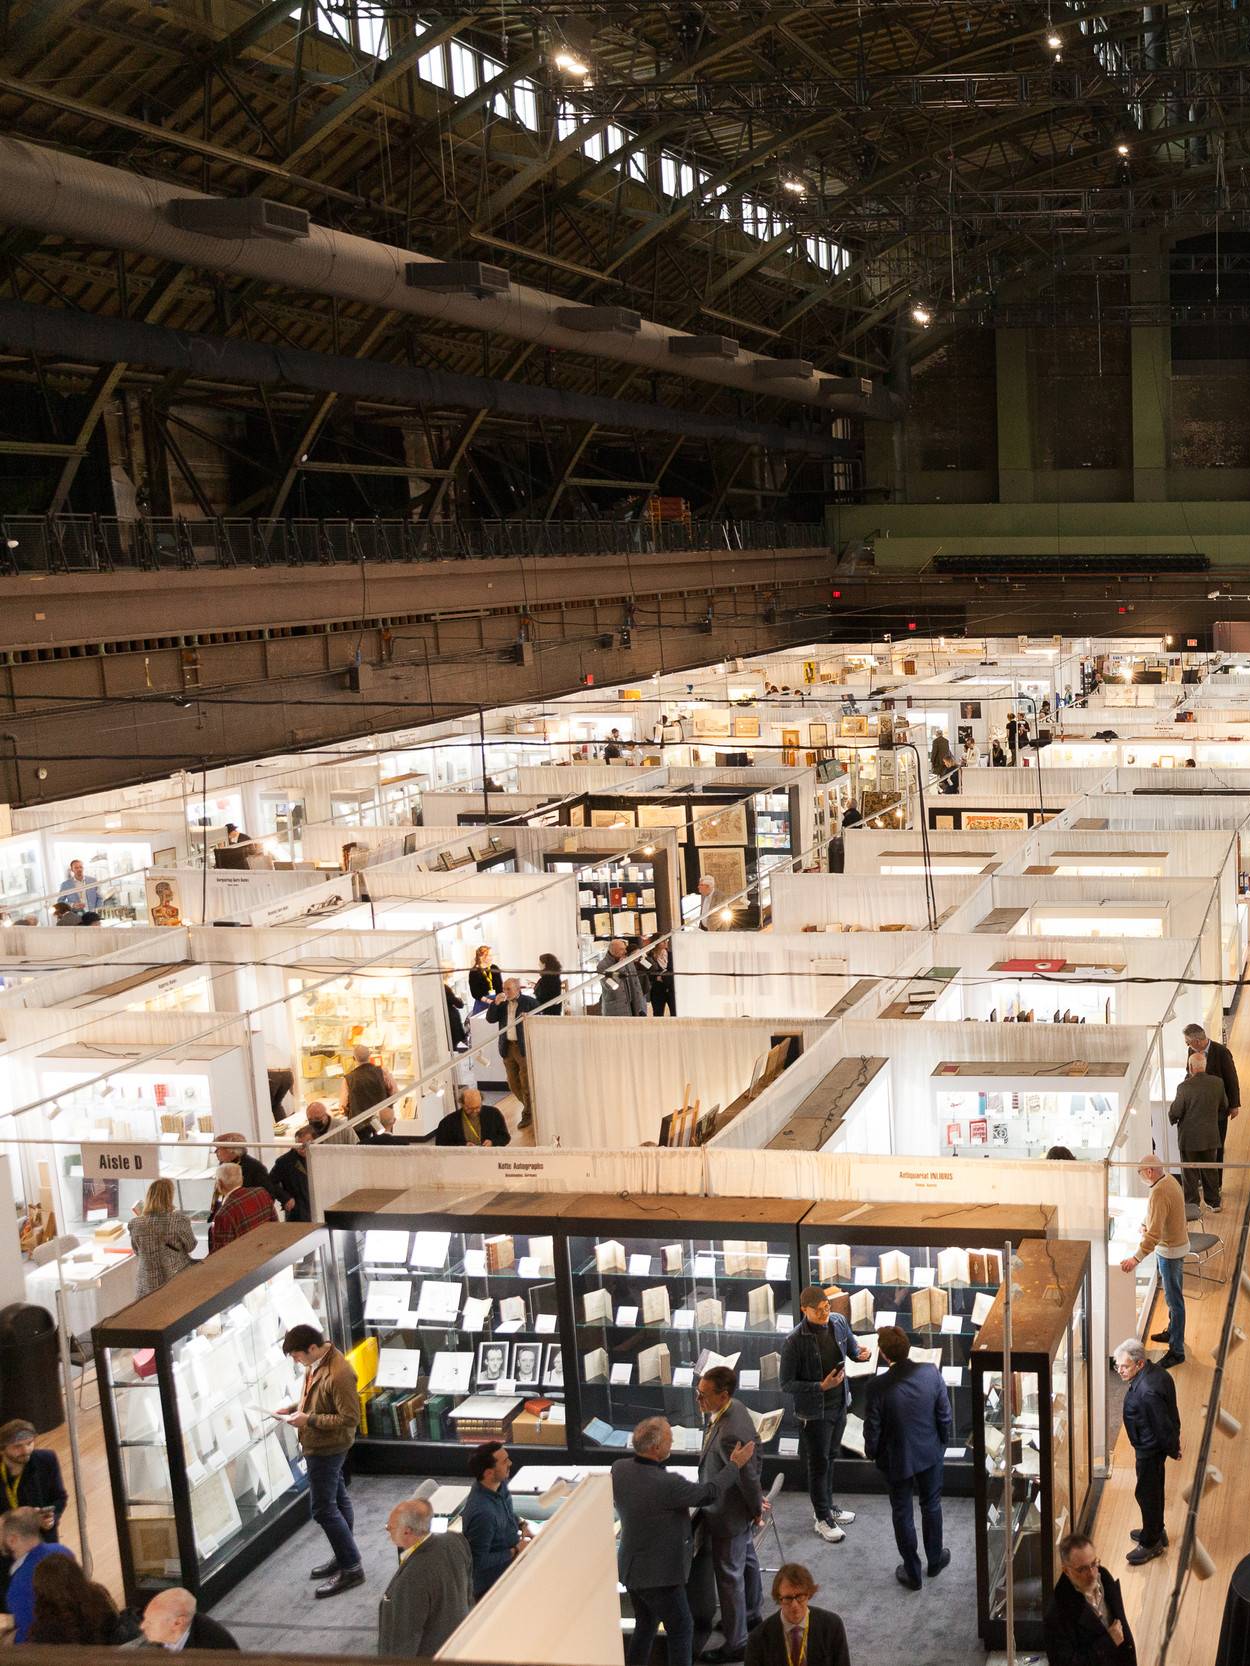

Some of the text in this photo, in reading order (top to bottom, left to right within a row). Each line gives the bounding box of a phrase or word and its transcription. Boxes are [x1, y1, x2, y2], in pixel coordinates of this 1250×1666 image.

[100, 1155, 142, 1169] Aisle D
[513, 1162, 544, 1171] Autographs
